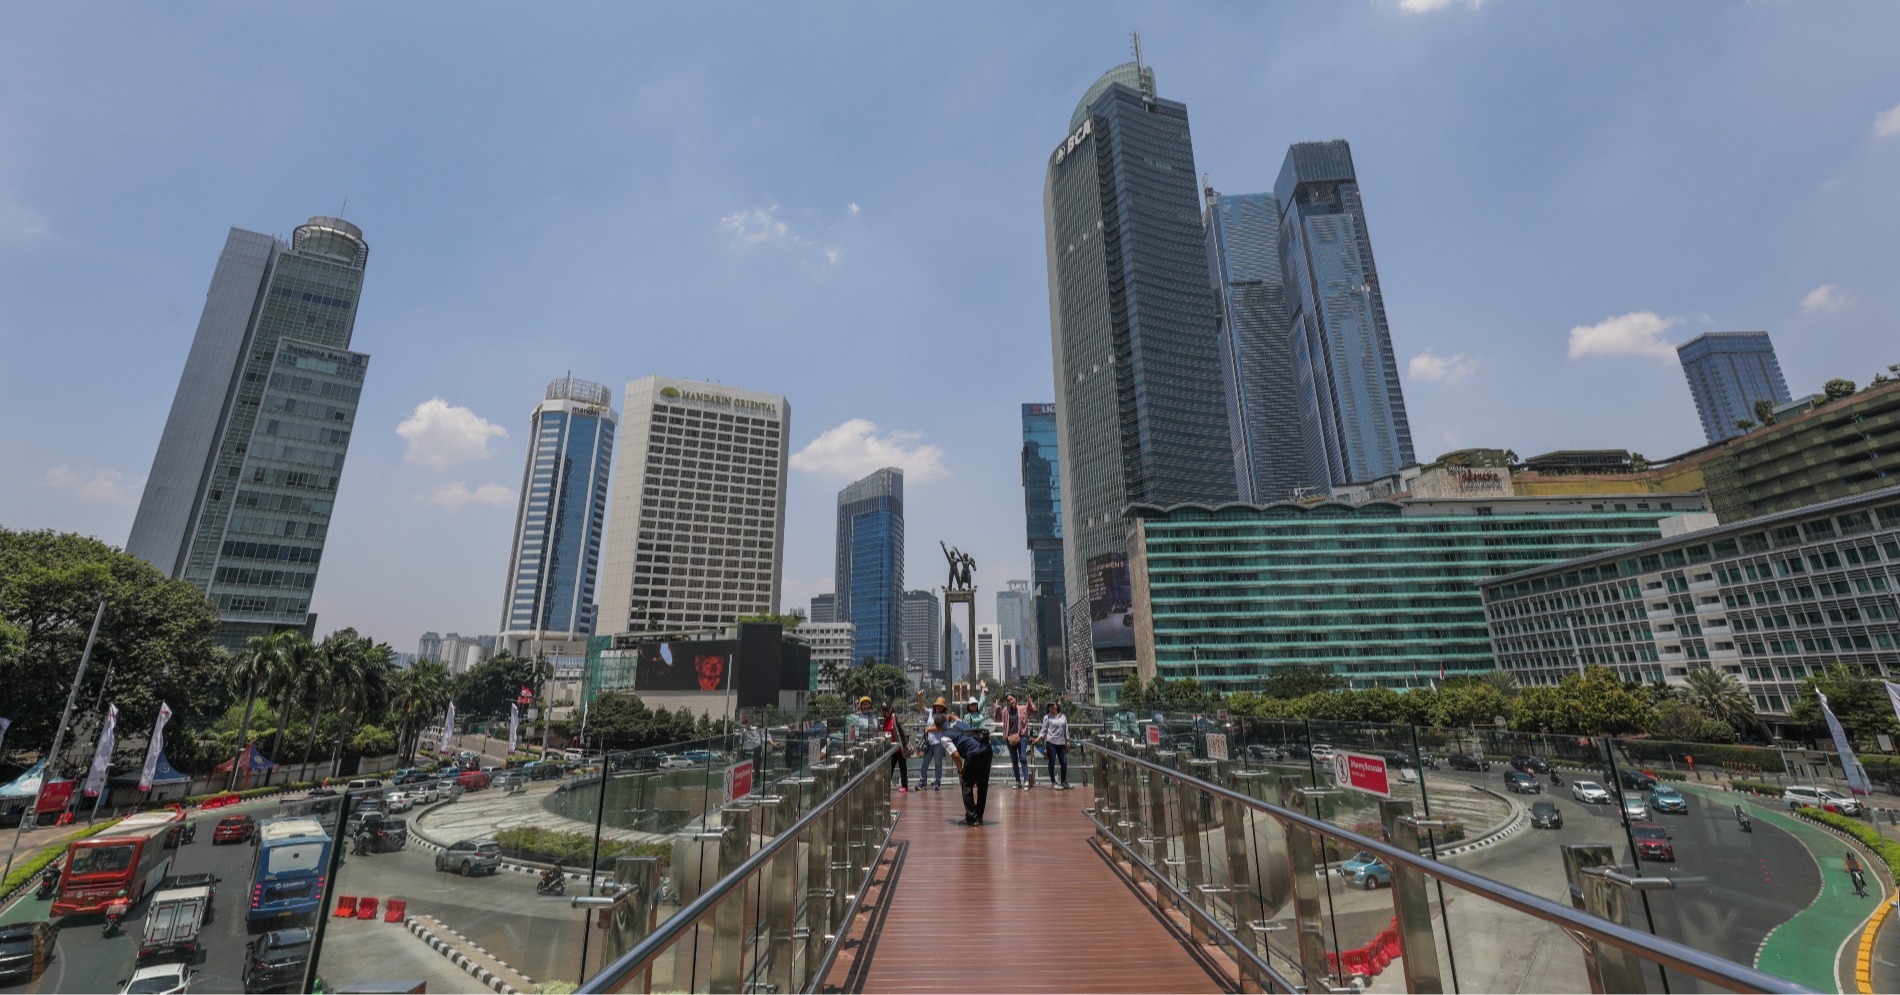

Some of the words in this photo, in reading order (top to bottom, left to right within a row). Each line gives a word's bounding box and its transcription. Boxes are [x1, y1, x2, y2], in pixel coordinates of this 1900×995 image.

[1067, 119, 1091, 155] BCA
[287, 344, 325, 358] Deutsche
[328, 351, 348, 362] Bank
[572, 406, 600, 417] mandiri
[682, 390, 732, 406] MANDARIN
[734, 398, 777, 413] ORIENTAL
